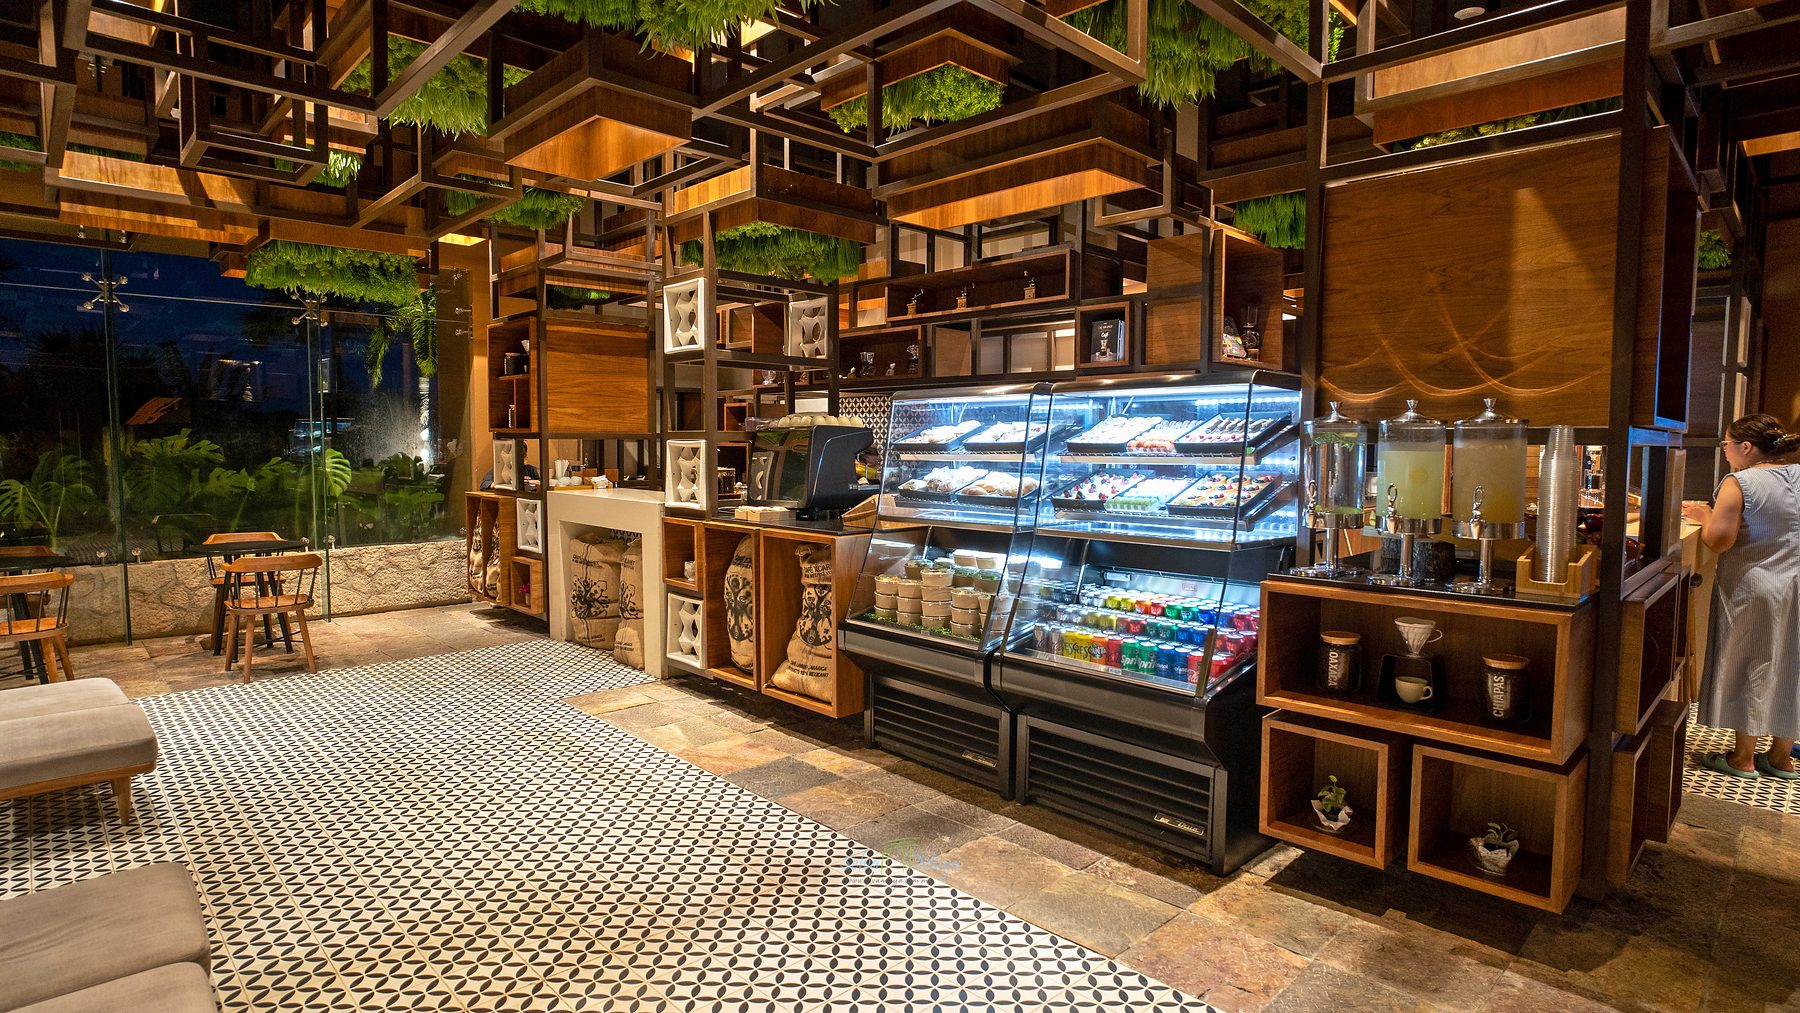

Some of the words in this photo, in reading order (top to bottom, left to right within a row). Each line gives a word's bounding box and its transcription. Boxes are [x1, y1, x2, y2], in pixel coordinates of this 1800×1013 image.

[1121, 654, 1138, 667] Spri
[1327, 651, 1339, 686] OAXACA
[1492, 675, 1506, 718] CHIAPAS
